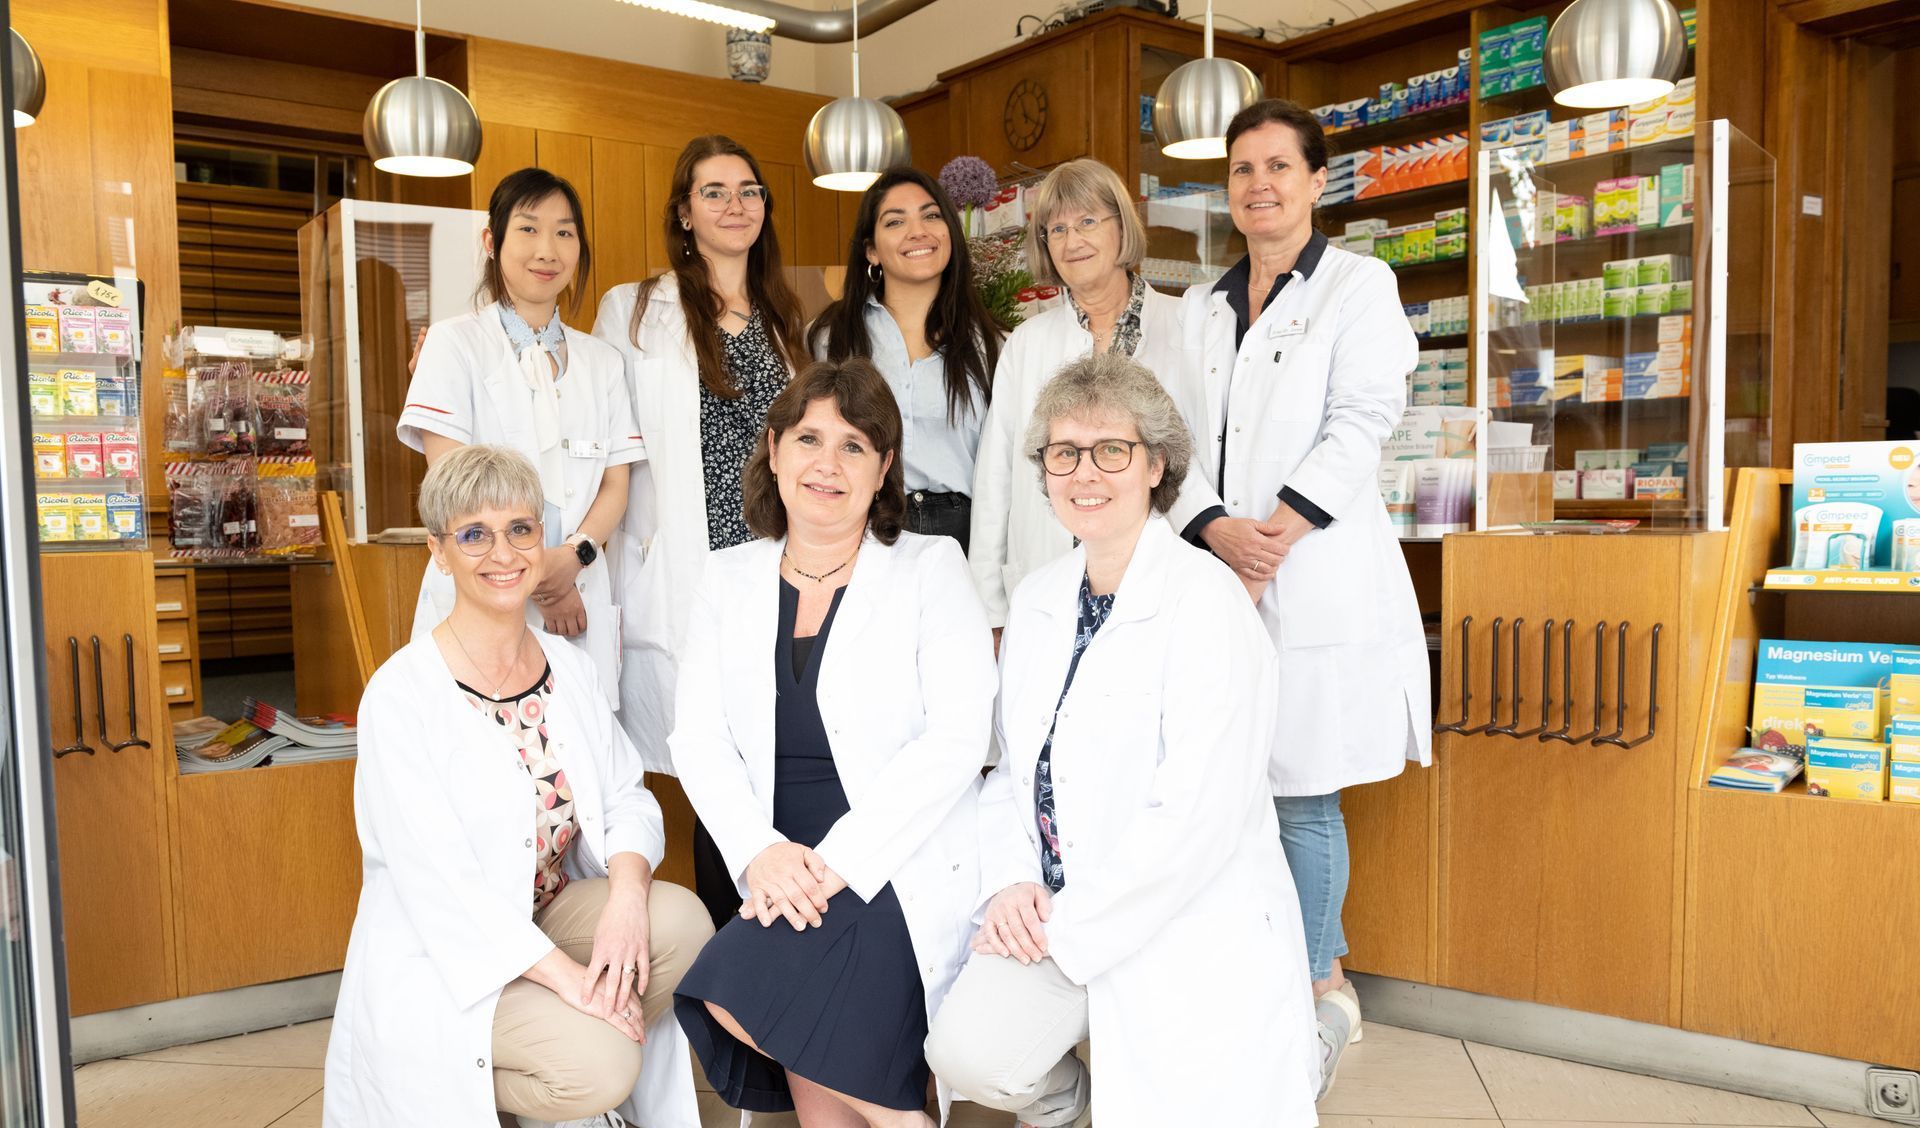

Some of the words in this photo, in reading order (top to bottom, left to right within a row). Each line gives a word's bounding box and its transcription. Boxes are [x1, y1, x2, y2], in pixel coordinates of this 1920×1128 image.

[68, 434, 99, 442] Ricola
[105, 433, 135, 441] Ricola
[1637, 479, 1677, 488] RIOPAN
[38, 496, 69, 504] Ricola
[73, 496, 103, 504] Ricola
[108, 495, 138, 504] Ricola
[1767, 646, 1864, 664] Magnesium
[1805, 690, 1842, 699] Magnesium
[1810, 748, 1848, 758] Magnesium
